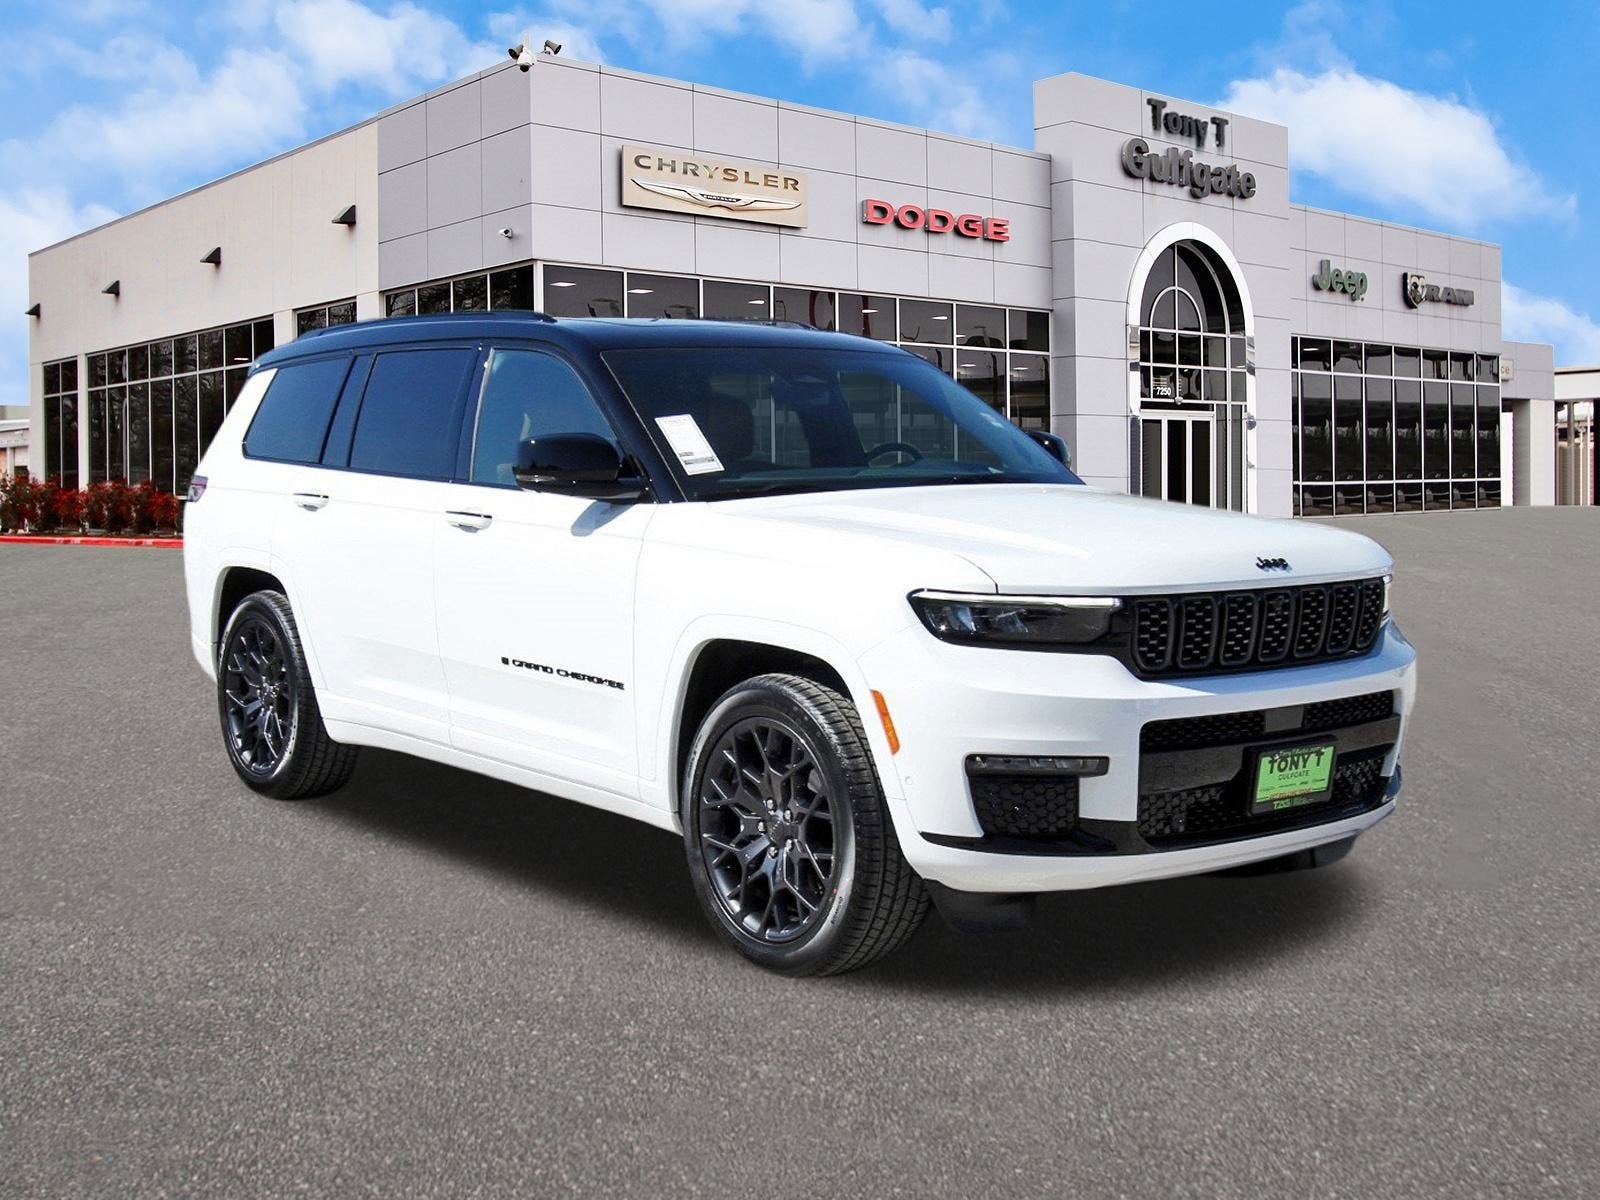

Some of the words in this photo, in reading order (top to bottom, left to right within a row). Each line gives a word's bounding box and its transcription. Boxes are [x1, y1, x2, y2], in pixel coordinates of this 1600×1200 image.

[1146, 98, 1209, 148] Tony
[1210, 116, 1229, 148] T
[633, 154, 801, 193] CHRYSLER
[1121, 138, 1257, 200] Gulfgate
[863, 198, 1011, 243] DODGE
[1312, 259, 1368, 302] Jeep
[1424, 284, 1475, 307] RAM
[1156, 387, 1172, 396] 7250
[511, 658, 554, 675] GRAND
[556, 668, 625, 691] CHEROKEE
[1268, 753, 1312, 775] TONY
[1314, 749, 1325, 768] T
